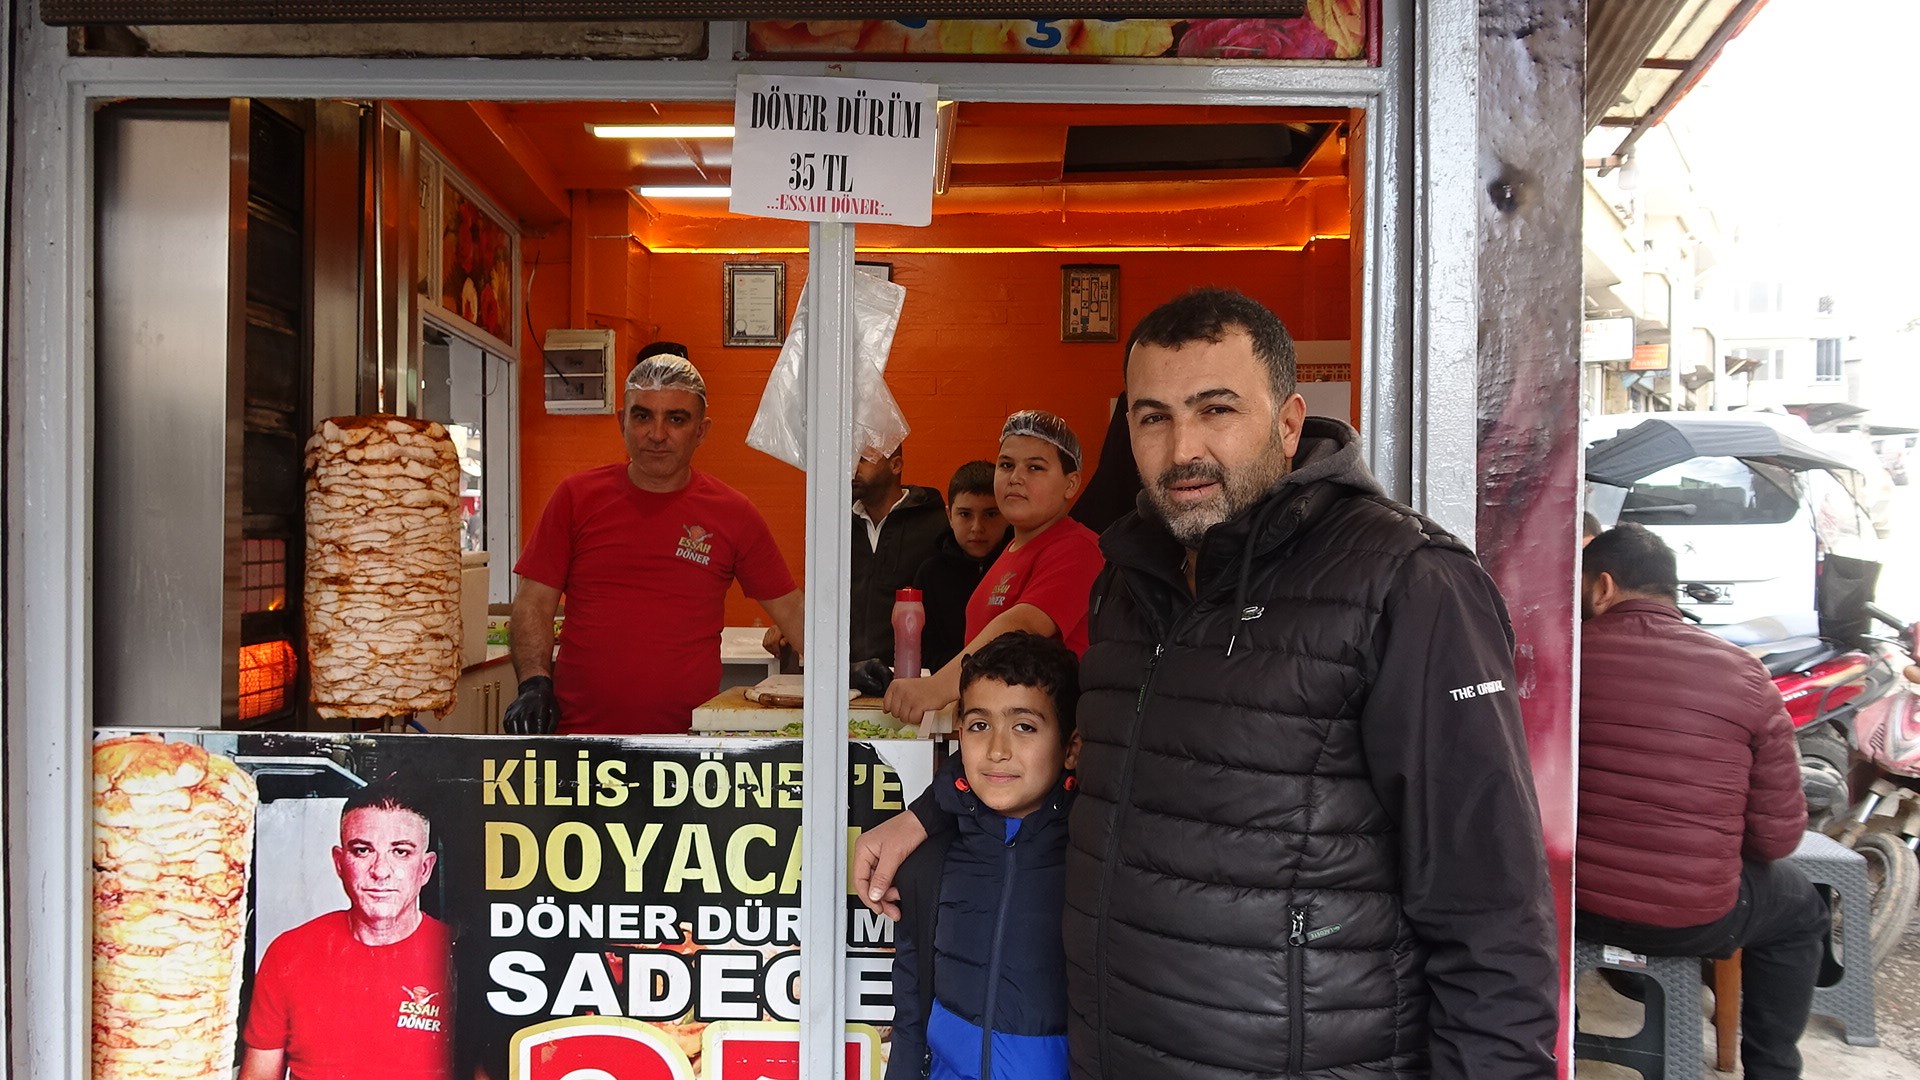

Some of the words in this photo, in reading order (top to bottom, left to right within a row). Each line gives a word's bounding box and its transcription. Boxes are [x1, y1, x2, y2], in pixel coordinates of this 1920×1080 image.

[750, 85, 828, 133] DÖNER
[835, 89, 922, 139] DÜRÜM
[788, 152, 815, 191] 35
[822, 153, 854, 193] TL
[678, 536, 711, 554] ESSAH
[675, 547, 710, 566] DÖNER
[1449, 685, 1476, 701] THE
[483, 749, 633, 808] KİLİS
[653, 752, 903, 810] DÖNE'E
[490, 896, 680, 939] DÖNER
[698, 899, 895, 943] DÜRM
[399, 1000, 440, 1018] ESSAH
[397, 1013, 442, 1032] DÖNER
